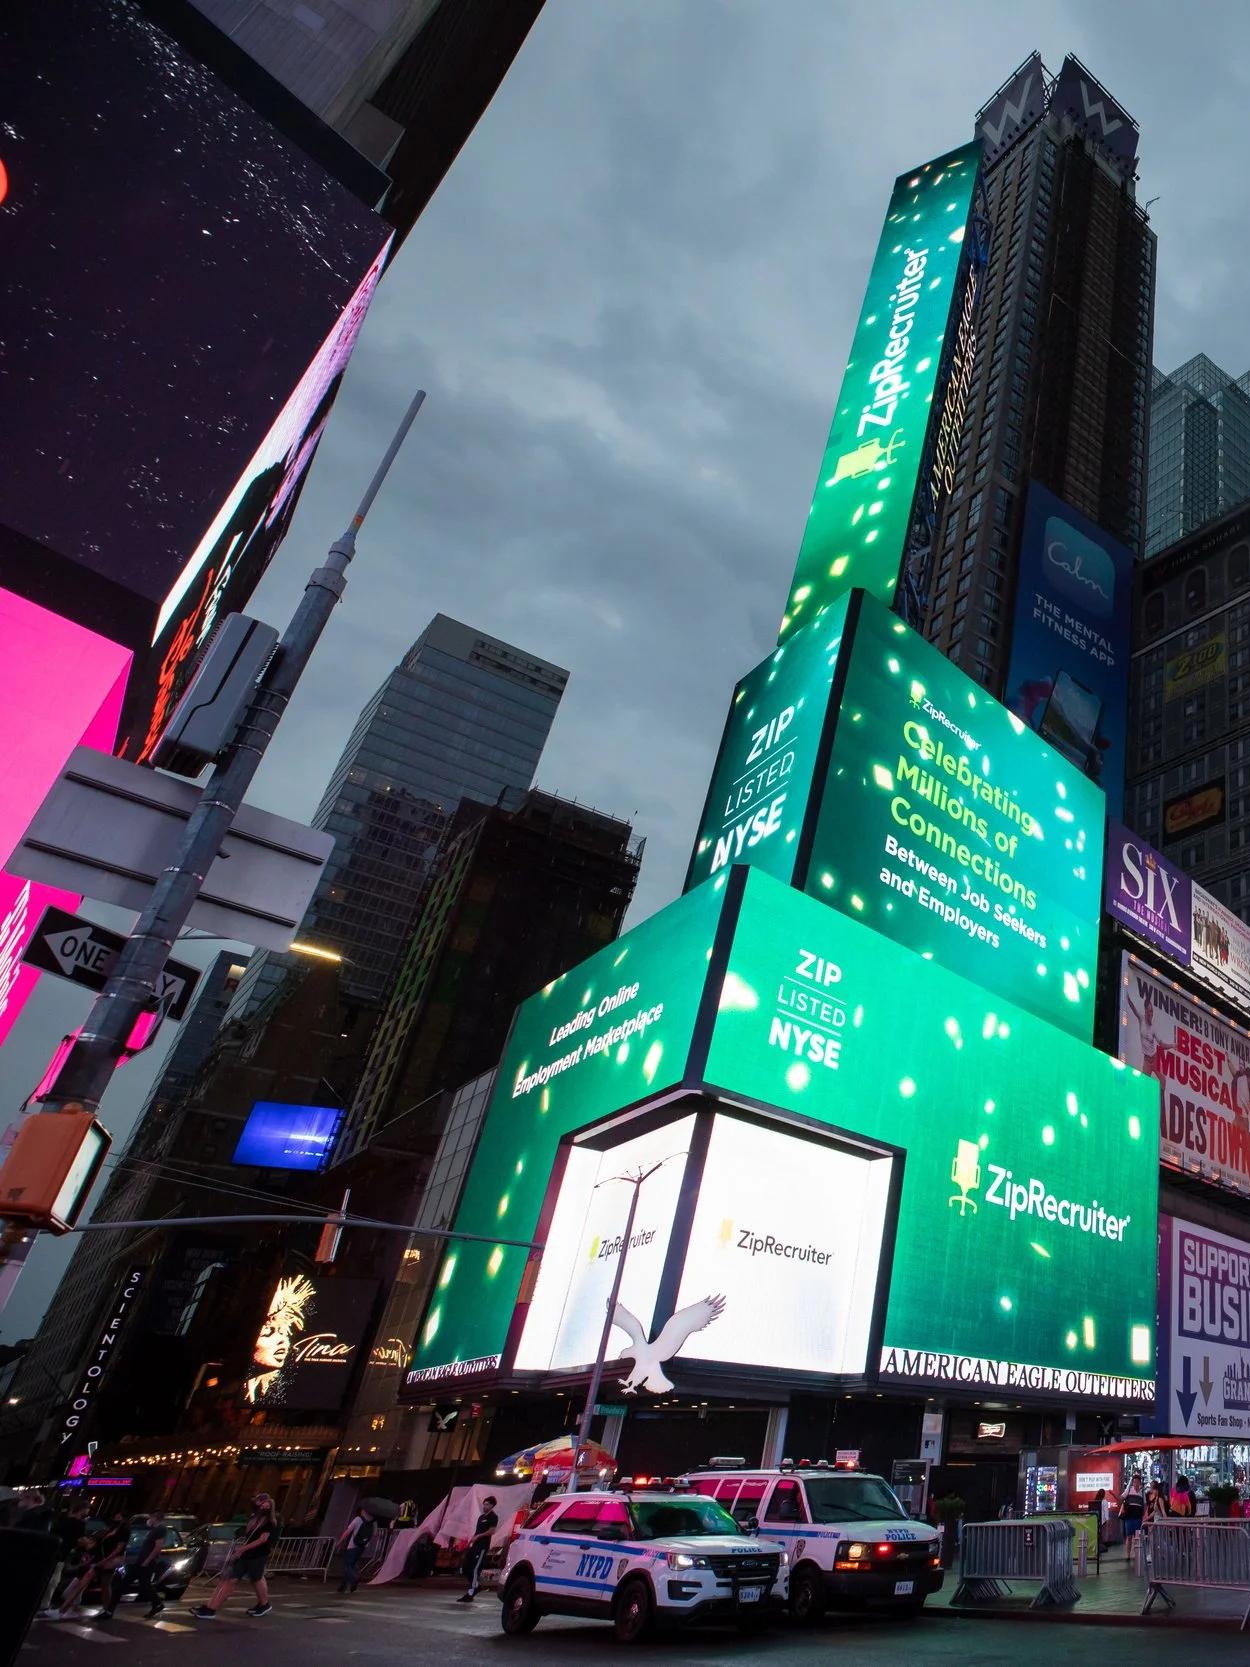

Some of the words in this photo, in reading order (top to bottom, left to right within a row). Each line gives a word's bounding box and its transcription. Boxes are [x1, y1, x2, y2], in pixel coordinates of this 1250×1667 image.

[981, 73, 1034, 148] W
[1079, 79, 1124, 136] W
[856, 247, 930, 437] ZipRecruiter
[1048, 541, 1110, 599] Calm
[1033, 608, 1087, 650] FITNESS
[1090, 648, 1115, 666] APP
[1035, 593, 1061, 619] THE
[1065, 613, 1115, 653] MENTAL
[745, 705, 795, 766] ZIP
[922, 699, 982, 751] ZipRecruiter
[724, 751, 795, 817] LISTED
[897, 755, 988, 839] Millions
[995, 832, 1018, 859] of
[903, 721, 1036, 837] Celebrating
[710, 793, 787, 874] NYSE
[891, 796, 1037, 910] Connections
[880, 866, 914, 898] and
[918, 886, 1001, 949] Employers
[885, 834, 957, 895] Between
[961, 881, 990, 913] Job
[994, 904, 1048, 949] Seekers
[60, 936, 111, 972] ONE
[796, 948, 842, 987] ZIP
[549, 1006, 597, 1046] Leading
[598, 982, 640, 1017] Online
[777, 984, 846, 1027] LISTED
[1136, 976, 1202, 1034] WINNER!
[1203, 1021, 1209, 1038] 8
[1210, 1023, 1229, 1050] TONY
[512, 1044, 583, 1098] Employment
[583, 1003, 664, 1060] Marketplace
[769, 1016, 842, 1070] NYSE
[1176, 1025, 1227, 1075] BEST
[1156, 1044, 1243, 1115] MUSICAL
[985, 1163, 1131, 1241] ZipRecruiter
[598, 1228, 657, 1262] ZipReruiter
[737, 1229, 833, 1265] ZipRecruiter
[60, 1272, 141, 1444] SCIENTOLOGY
[292, 1333, 356, 1362] Tina
[884, 1348, 1000, 1382] AMERICAN
[1006, 1362, 1061, 1390] EAGLE
[1065, 1371, 1155, 1400] OUTFITTERS
[1197, 1413, 1216, 1428] Sports
[1218, 1414, 1228, 1426] Fan
[1229, 1416, 1243, 1429] Shop
[575, 1554, 613, 1580] NYPD
[885, 1533, 916, 1541] POLICE
